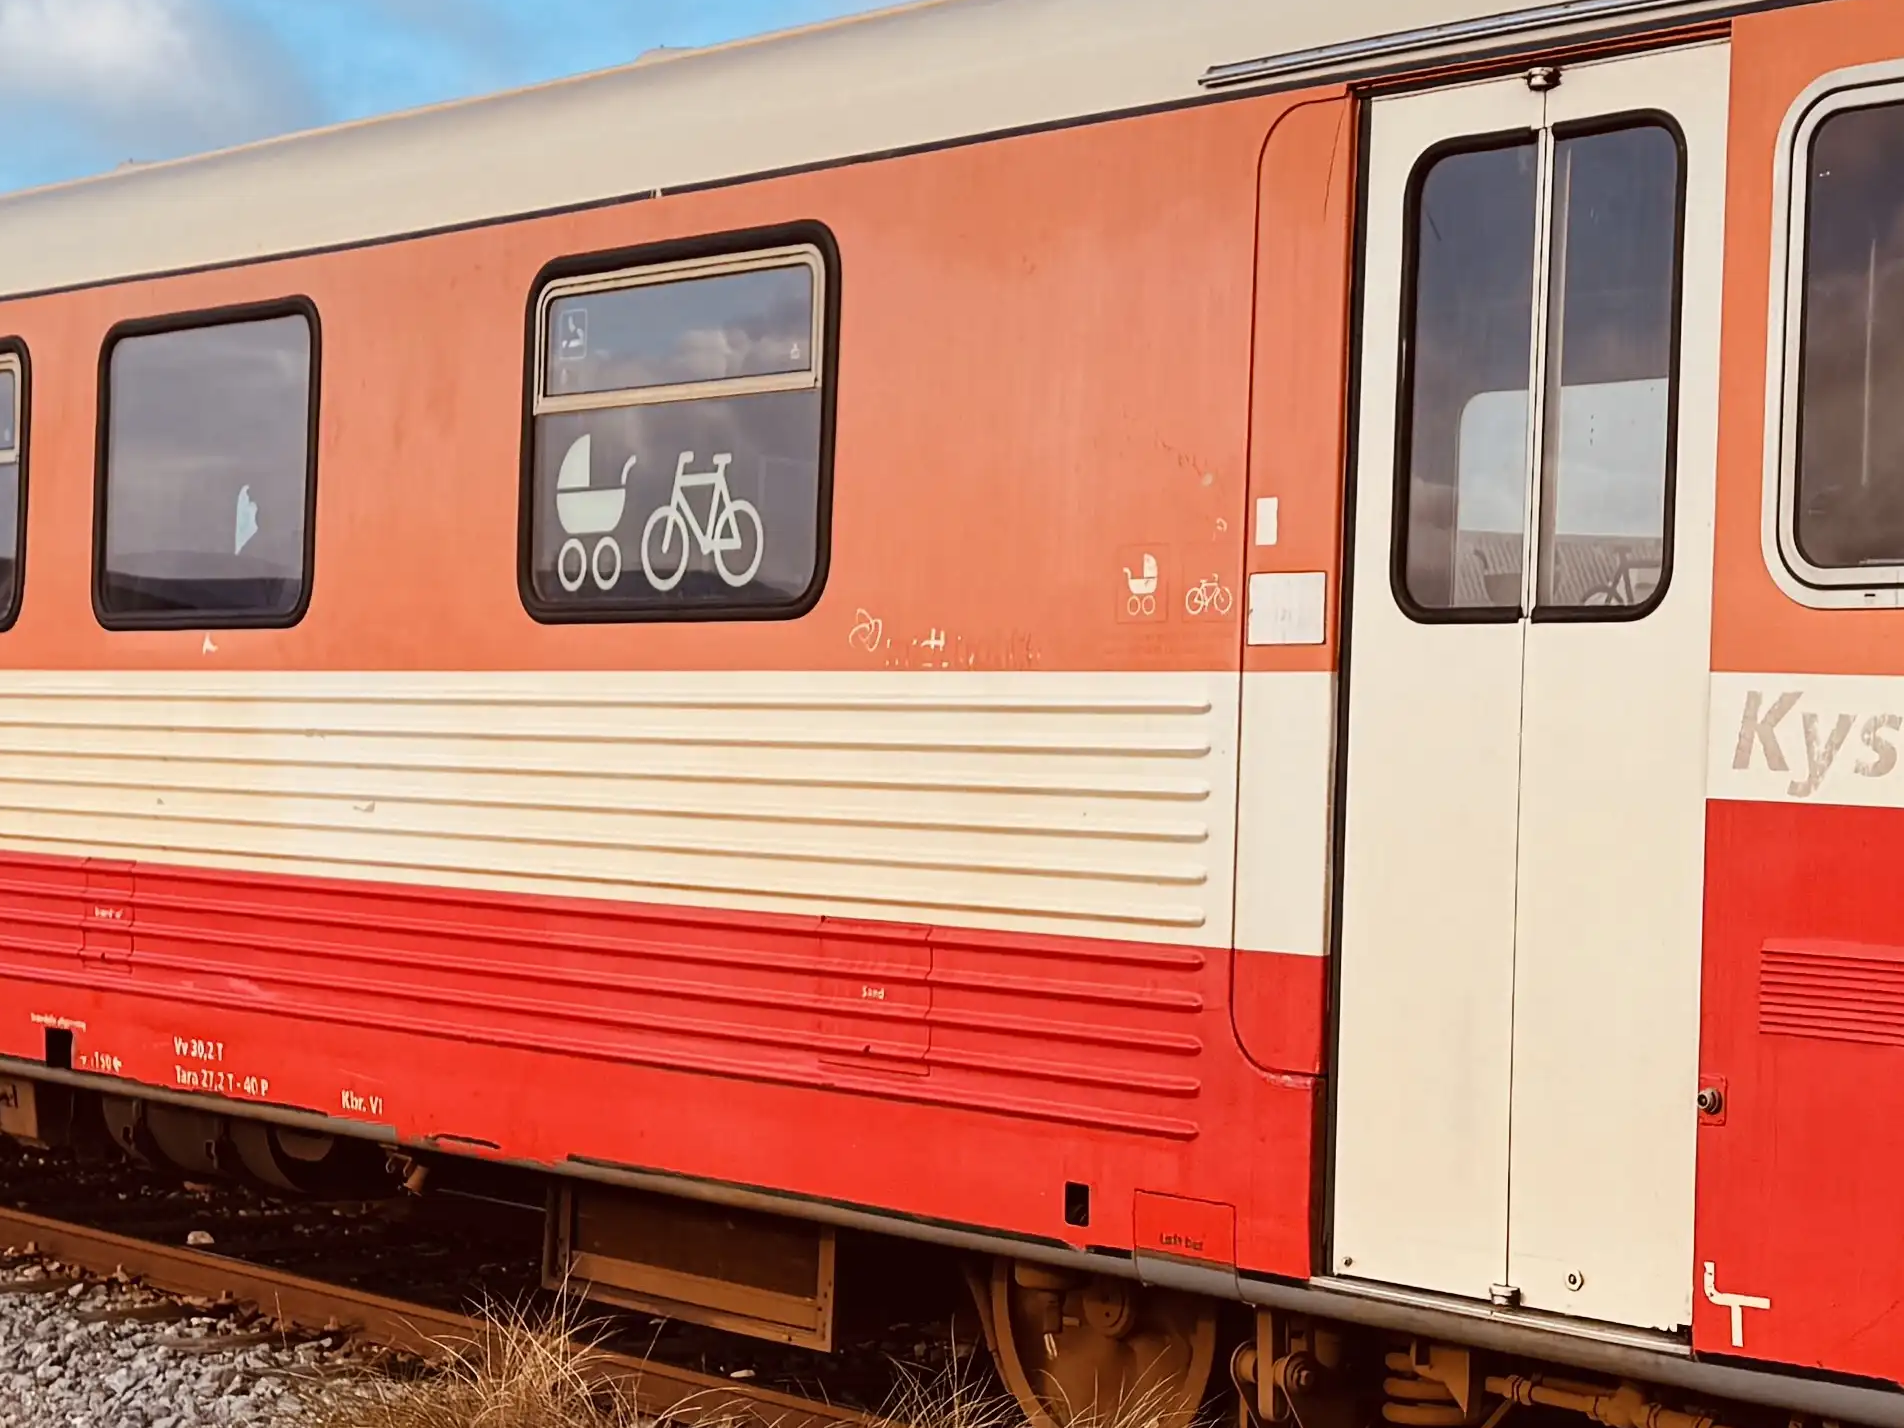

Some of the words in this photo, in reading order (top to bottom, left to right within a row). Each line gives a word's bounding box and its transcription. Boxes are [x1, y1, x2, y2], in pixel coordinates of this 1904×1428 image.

[190, 1038, 214, 1061] 30,2
[216, 1041, 224, 1062] T
[175, 1064, 199, 1087] Tara
[201, 1068, 224, 1092] 27,2
[226, 1072, 234, 1092] T
[243, 1075, 258, 1096] 40
[260, 1078, 269, 1097] P
[341, 1088, 367, 1113] Kbr.
